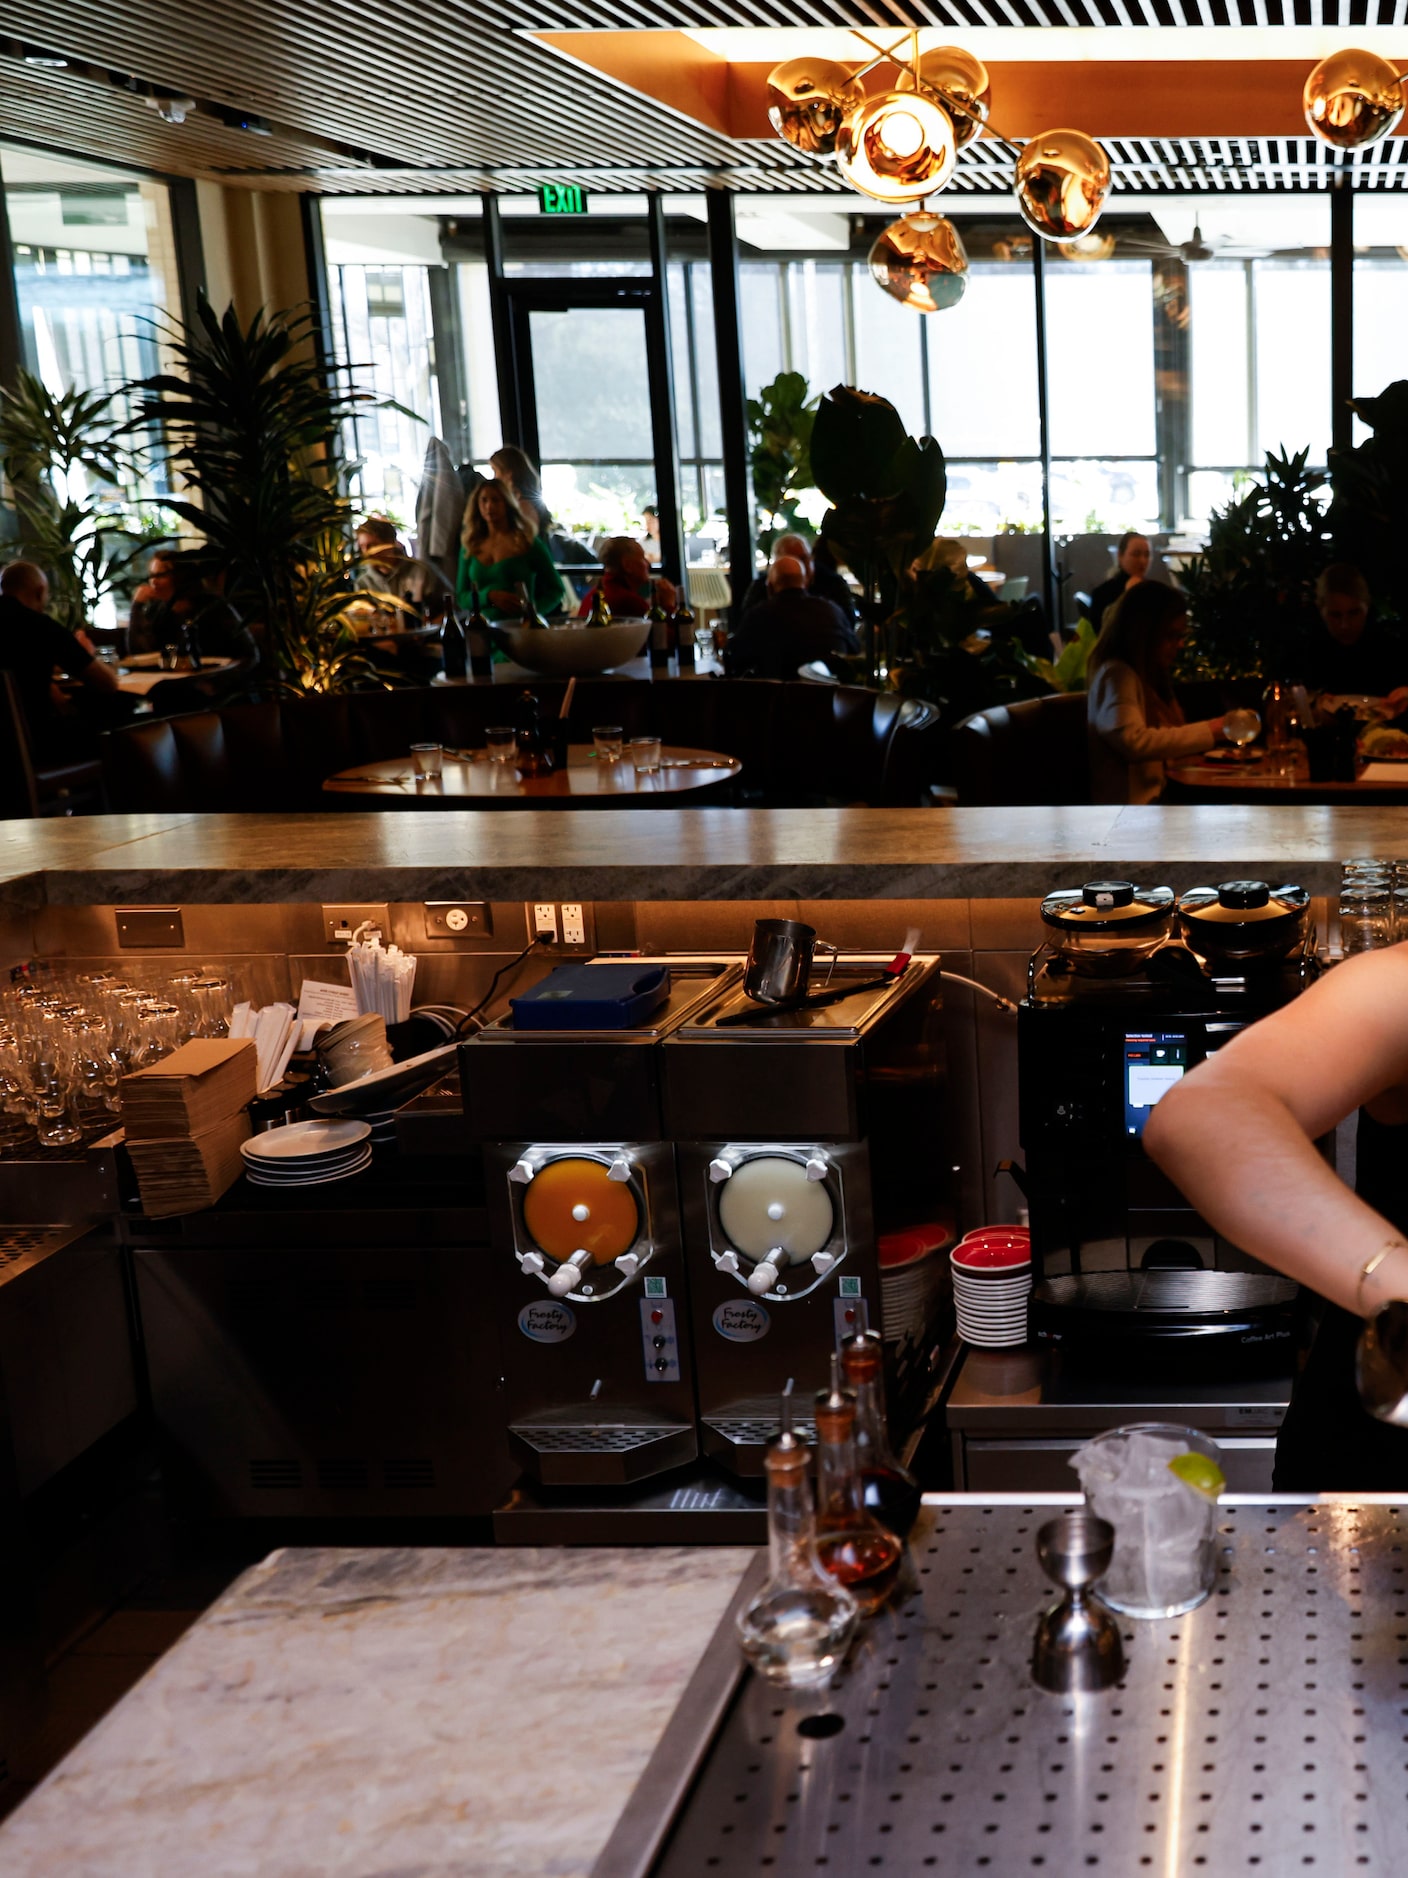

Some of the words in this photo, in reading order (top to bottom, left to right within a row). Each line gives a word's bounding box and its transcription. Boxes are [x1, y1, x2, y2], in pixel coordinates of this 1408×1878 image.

[543, 183, 582, 213] EXIT
[528, 1308, 563, 1322] Frosty
[724, 1307, 758, 1321] Frosty
[527, 1319, 567, 1334] Factory
[721, 1318, 761, 1333] Factory
